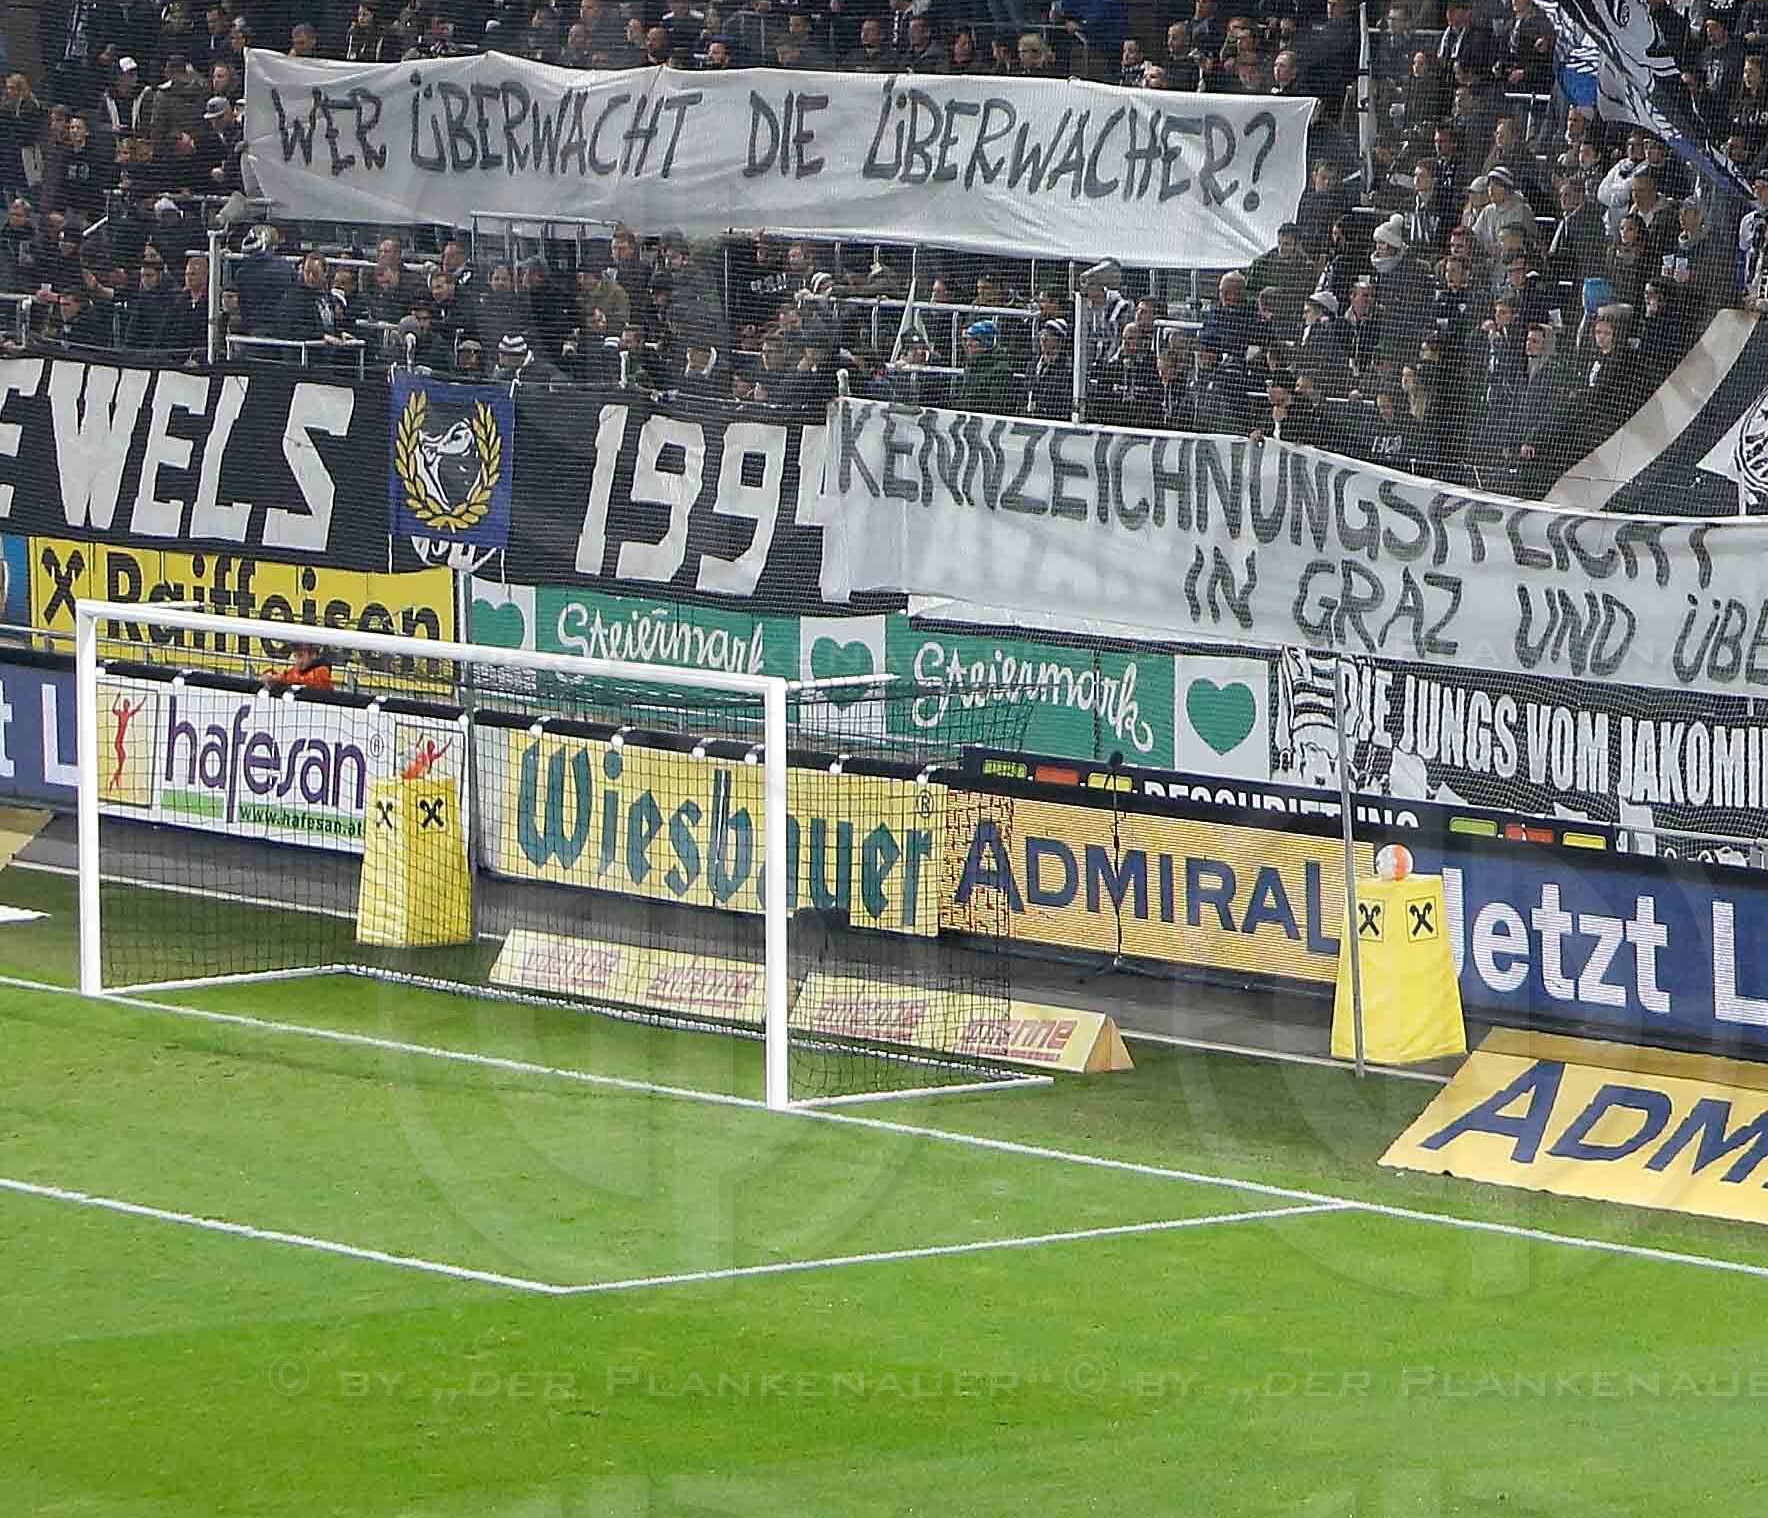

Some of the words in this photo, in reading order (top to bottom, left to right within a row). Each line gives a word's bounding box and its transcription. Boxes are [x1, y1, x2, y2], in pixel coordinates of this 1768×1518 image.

[273, 87, 387, 175] WER
[410, 72, 702, 181] ÜBERWACHT
[744, 90, 830, 180] DIE
[864, 73, 1275, 213] ÜBERWACHER?
[0, 356, 355, 553] EWELS
[837, 399, 1715, 591] KENNZEICHNUNGSPFLICHT
[557, 600, 765, 678] Steiermark
[1184, 545, 1258, 631] IN
[1295, 556, 1463, 658] GRAZ
[1516, 584, 1638, 677] UND
[165, 694, 368, 823] hafesan
[912, 642, 1155, 754] Steiermark
[1343, 657, 1394, 752] DIE
[1401, 674, 1519, 779] JUNGS
[1525, 702, 1610, 795] VOM
[240, 806, 364, 838] www.hafesan.at
[519, 735, 933, 934] Wiesbauer
[954, 817, 1341, 955] ADMIRAL
[1443, 865, 1671, 1015] Jetzt
